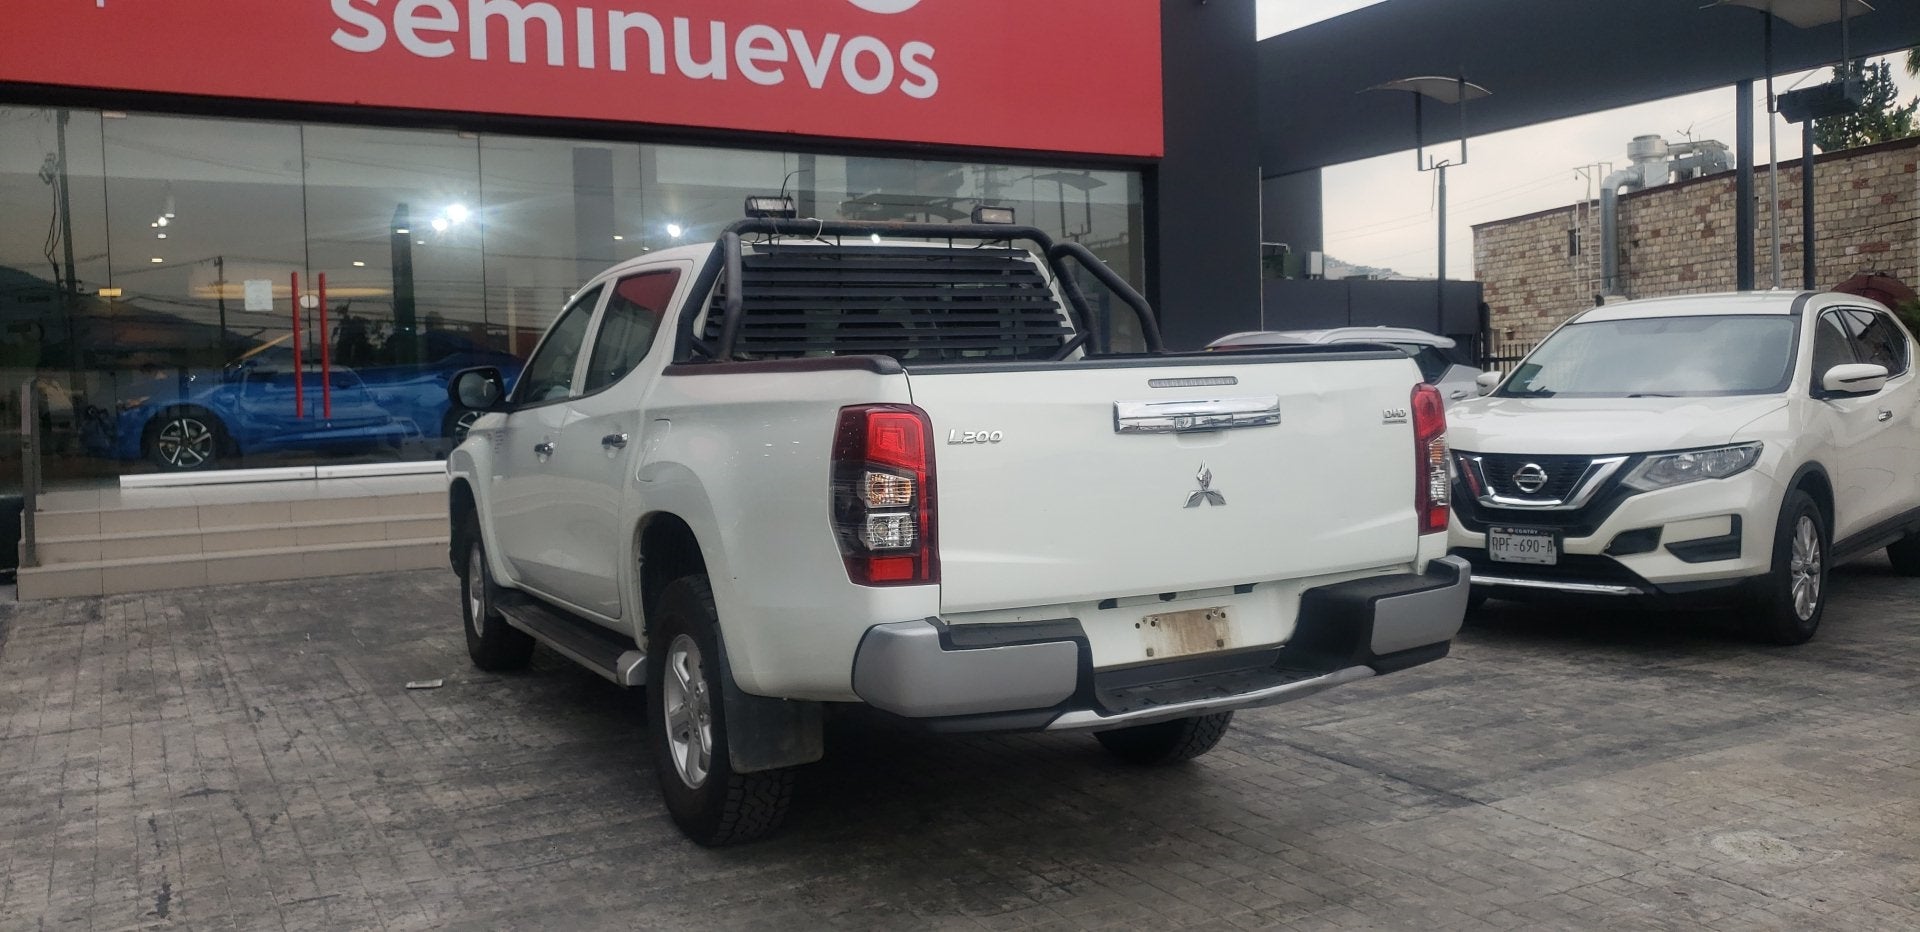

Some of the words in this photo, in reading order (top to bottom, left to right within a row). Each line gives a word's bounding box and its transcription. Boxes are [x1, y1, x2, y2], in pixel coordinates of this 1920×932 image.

[331, 0, 939, 99] seminuevos
[947, 429, 1003, 445] L200
[1492, 536, 1553, 554] RPF-690-A
